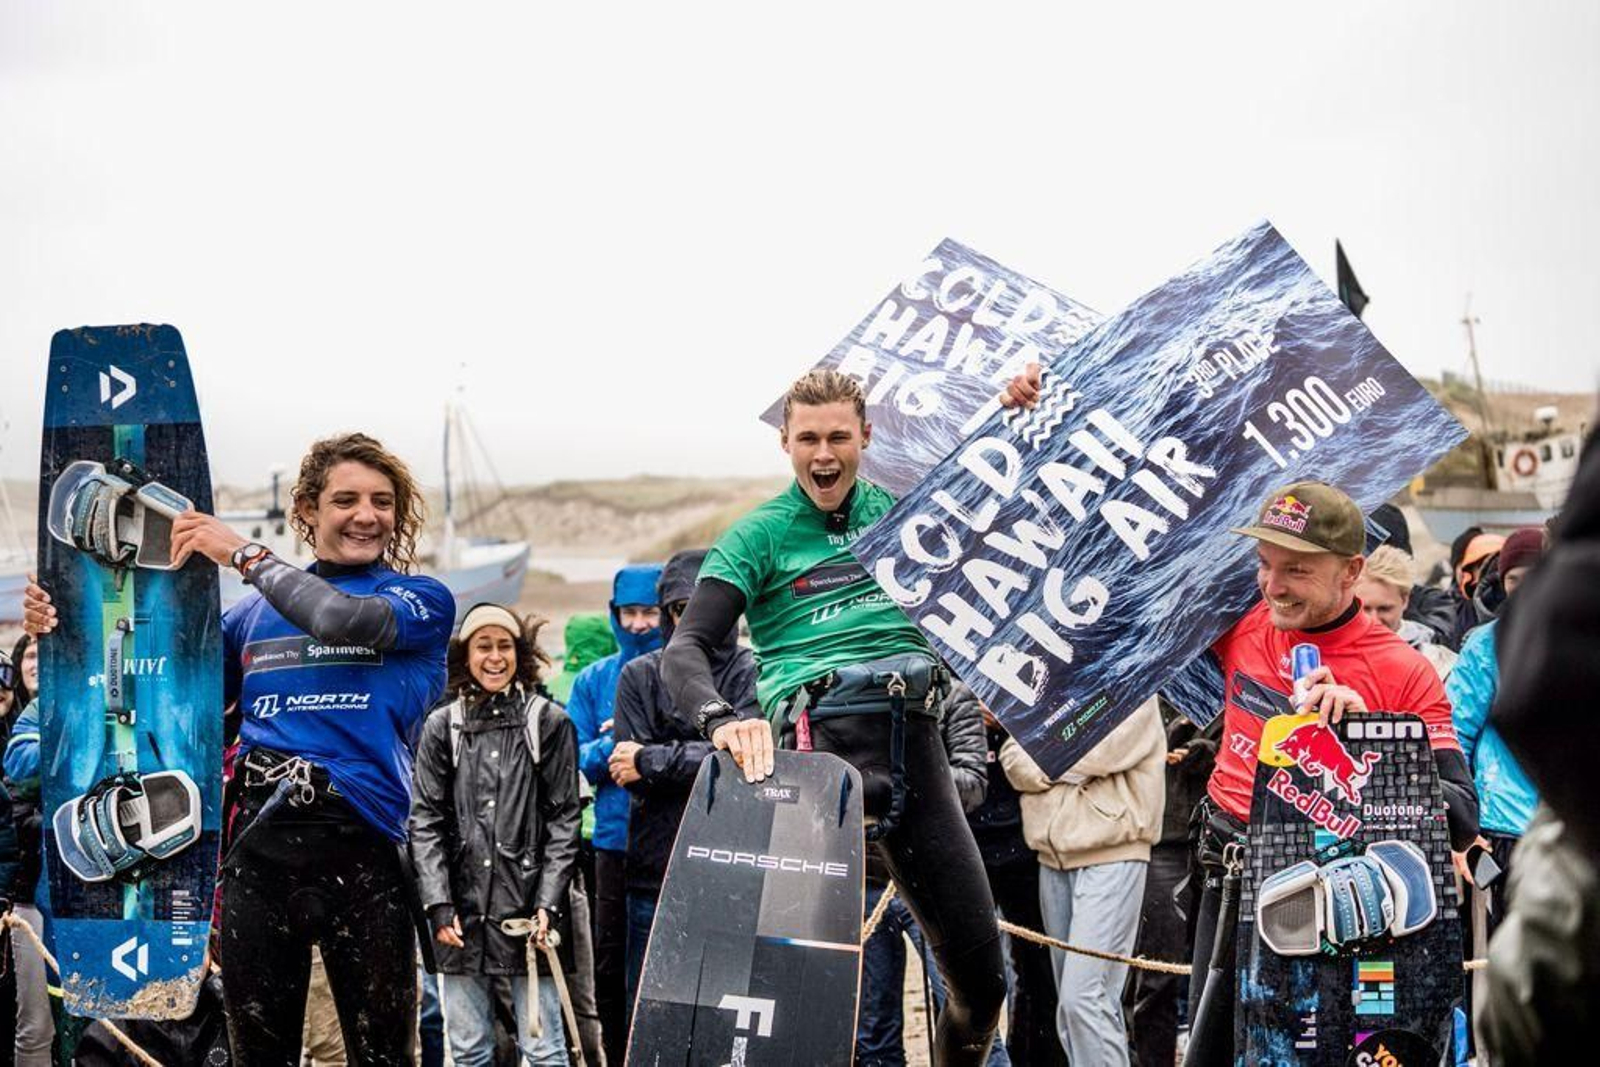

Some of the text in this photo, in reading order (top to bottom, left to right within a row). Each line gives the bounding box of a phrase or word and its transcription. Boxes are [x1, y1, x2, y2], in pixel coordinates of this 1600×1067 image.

[900, 257, 1058, 334] COLD
[860, 299, 1041, 385] HAWA
[1212, 331, 1281, 380] PLACE
[836, 344, 948, 418] BIG
[1242, 376, 1387, 469] 1.300 EURO
[875, 436, 1024, 608] COLD
[920, 408, 1144, 662] HAWAII
[849, 593, 892, 606] NOR
[975, 436, 1216, 706] BIG AIR
[110, 647, 118, 686] DUOTONE
[122, 656, 168, 675] JAIM
[285, 693, 370, 705] NORTH
[286, 703, 368, 713] KITEBOARDING
[687, 846, 848, 876] PORSCHE
